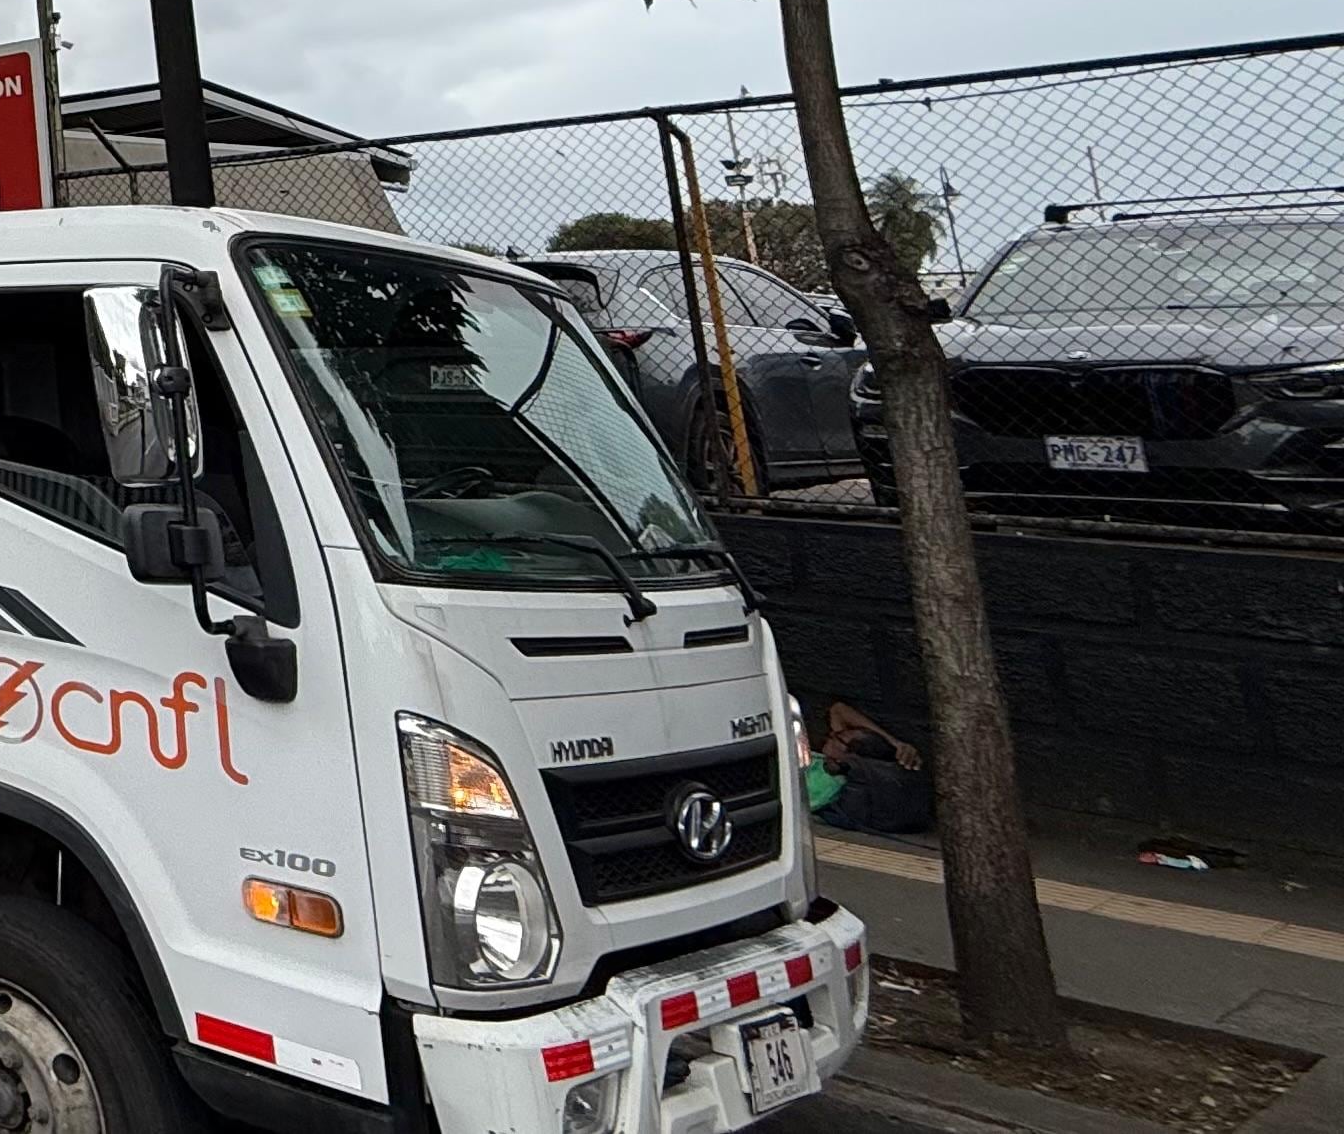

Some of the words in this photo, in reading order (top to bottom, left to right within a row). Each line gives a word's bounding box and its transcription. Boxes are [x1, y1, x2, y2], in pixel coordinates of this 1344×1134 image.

[51, 671, 249, 785] cnfl
[730, 712, 773, 739] MIGHTY
[550, 736, 614, 763] HYUNDAI
[240, 848, 336, 878] EX100
